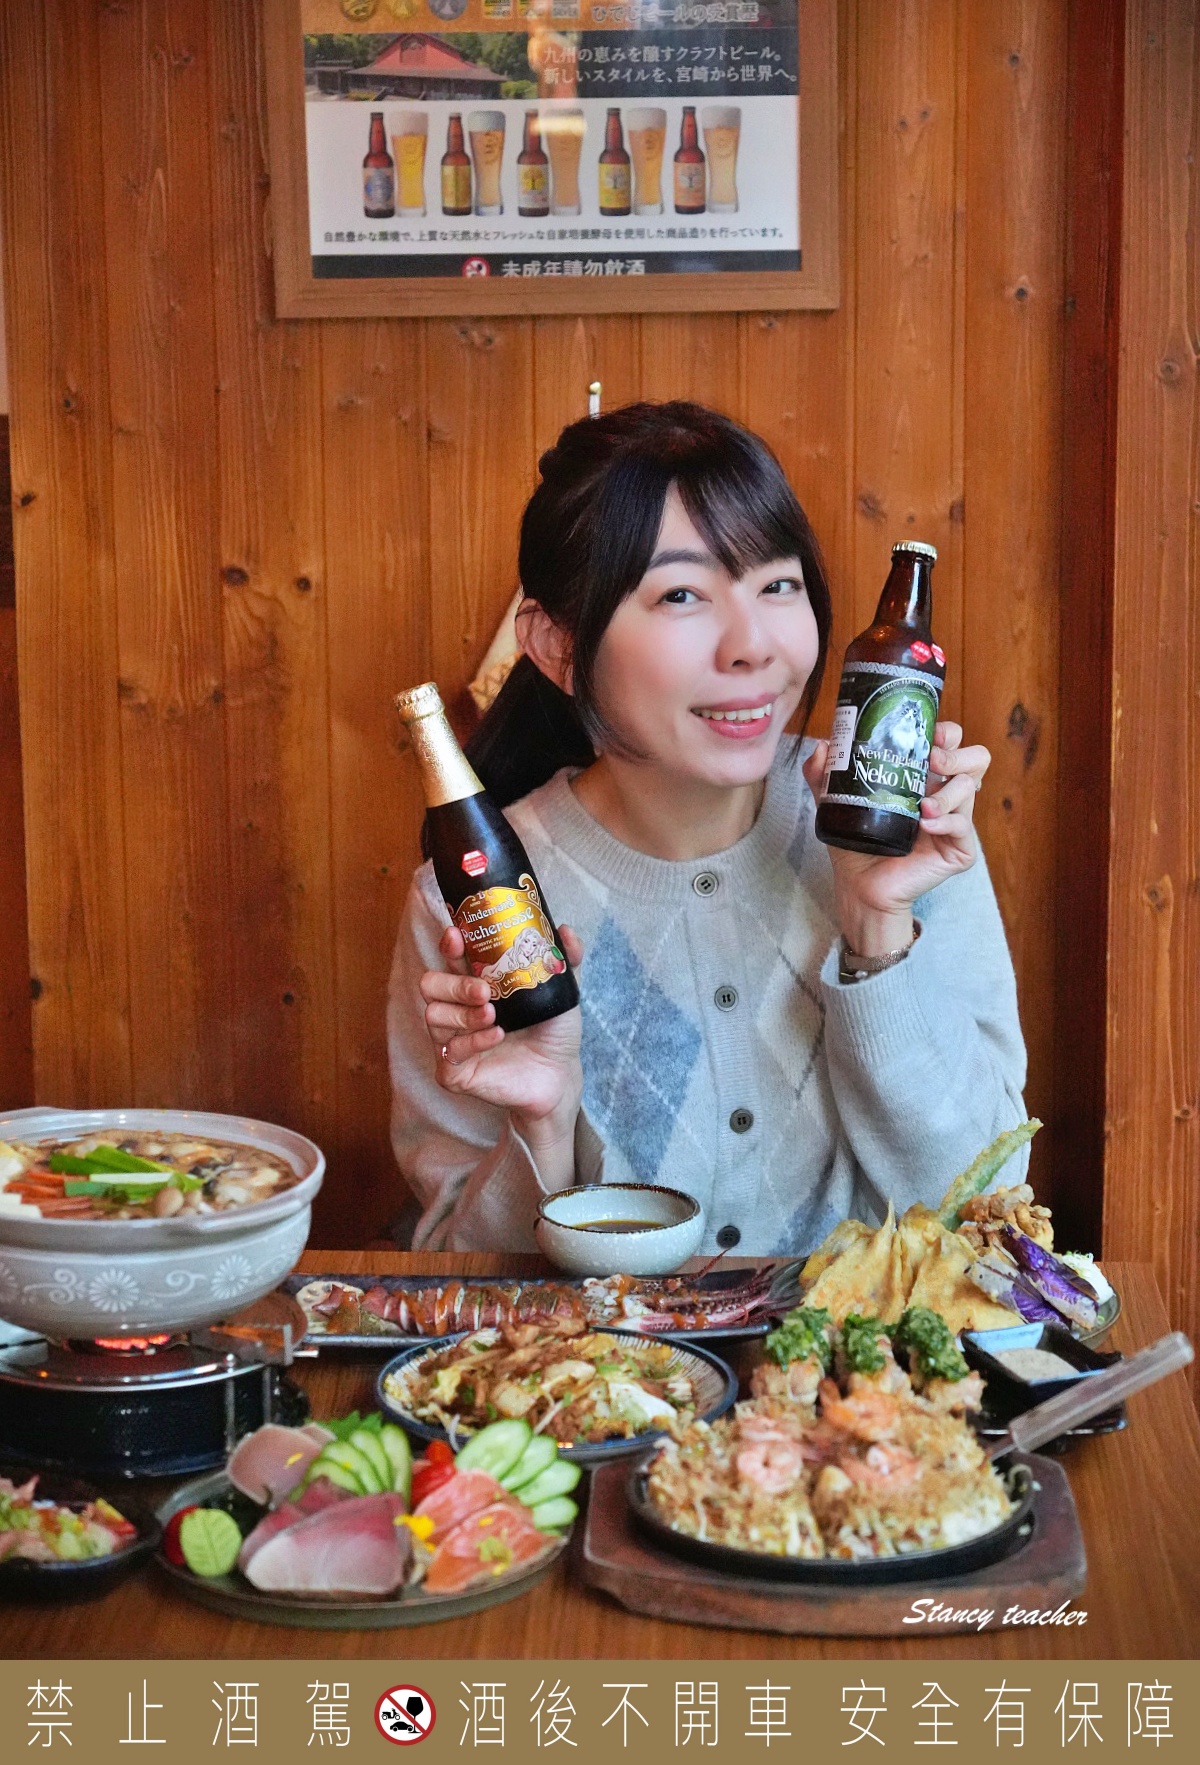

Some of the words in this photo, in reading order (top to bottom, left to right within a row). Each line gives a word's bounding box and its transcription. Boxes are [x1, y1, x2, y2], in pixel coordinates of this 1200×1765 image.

[592, 3, 760, 23] ひでじビールの受賞歴
[544, 46, 782, 64] 九州の恵みを醸すクラフトビール。
[544, 65, 798, 85] 新しいスタイルを、宮崎から世界へ。
[502, 259, 646, 278] 未成年請勿飲酒
[853, 760, 899, 787] Neko
[462, 893, 516, 924] Lindemans
[461, 906, 535, 944] Pecheresse
